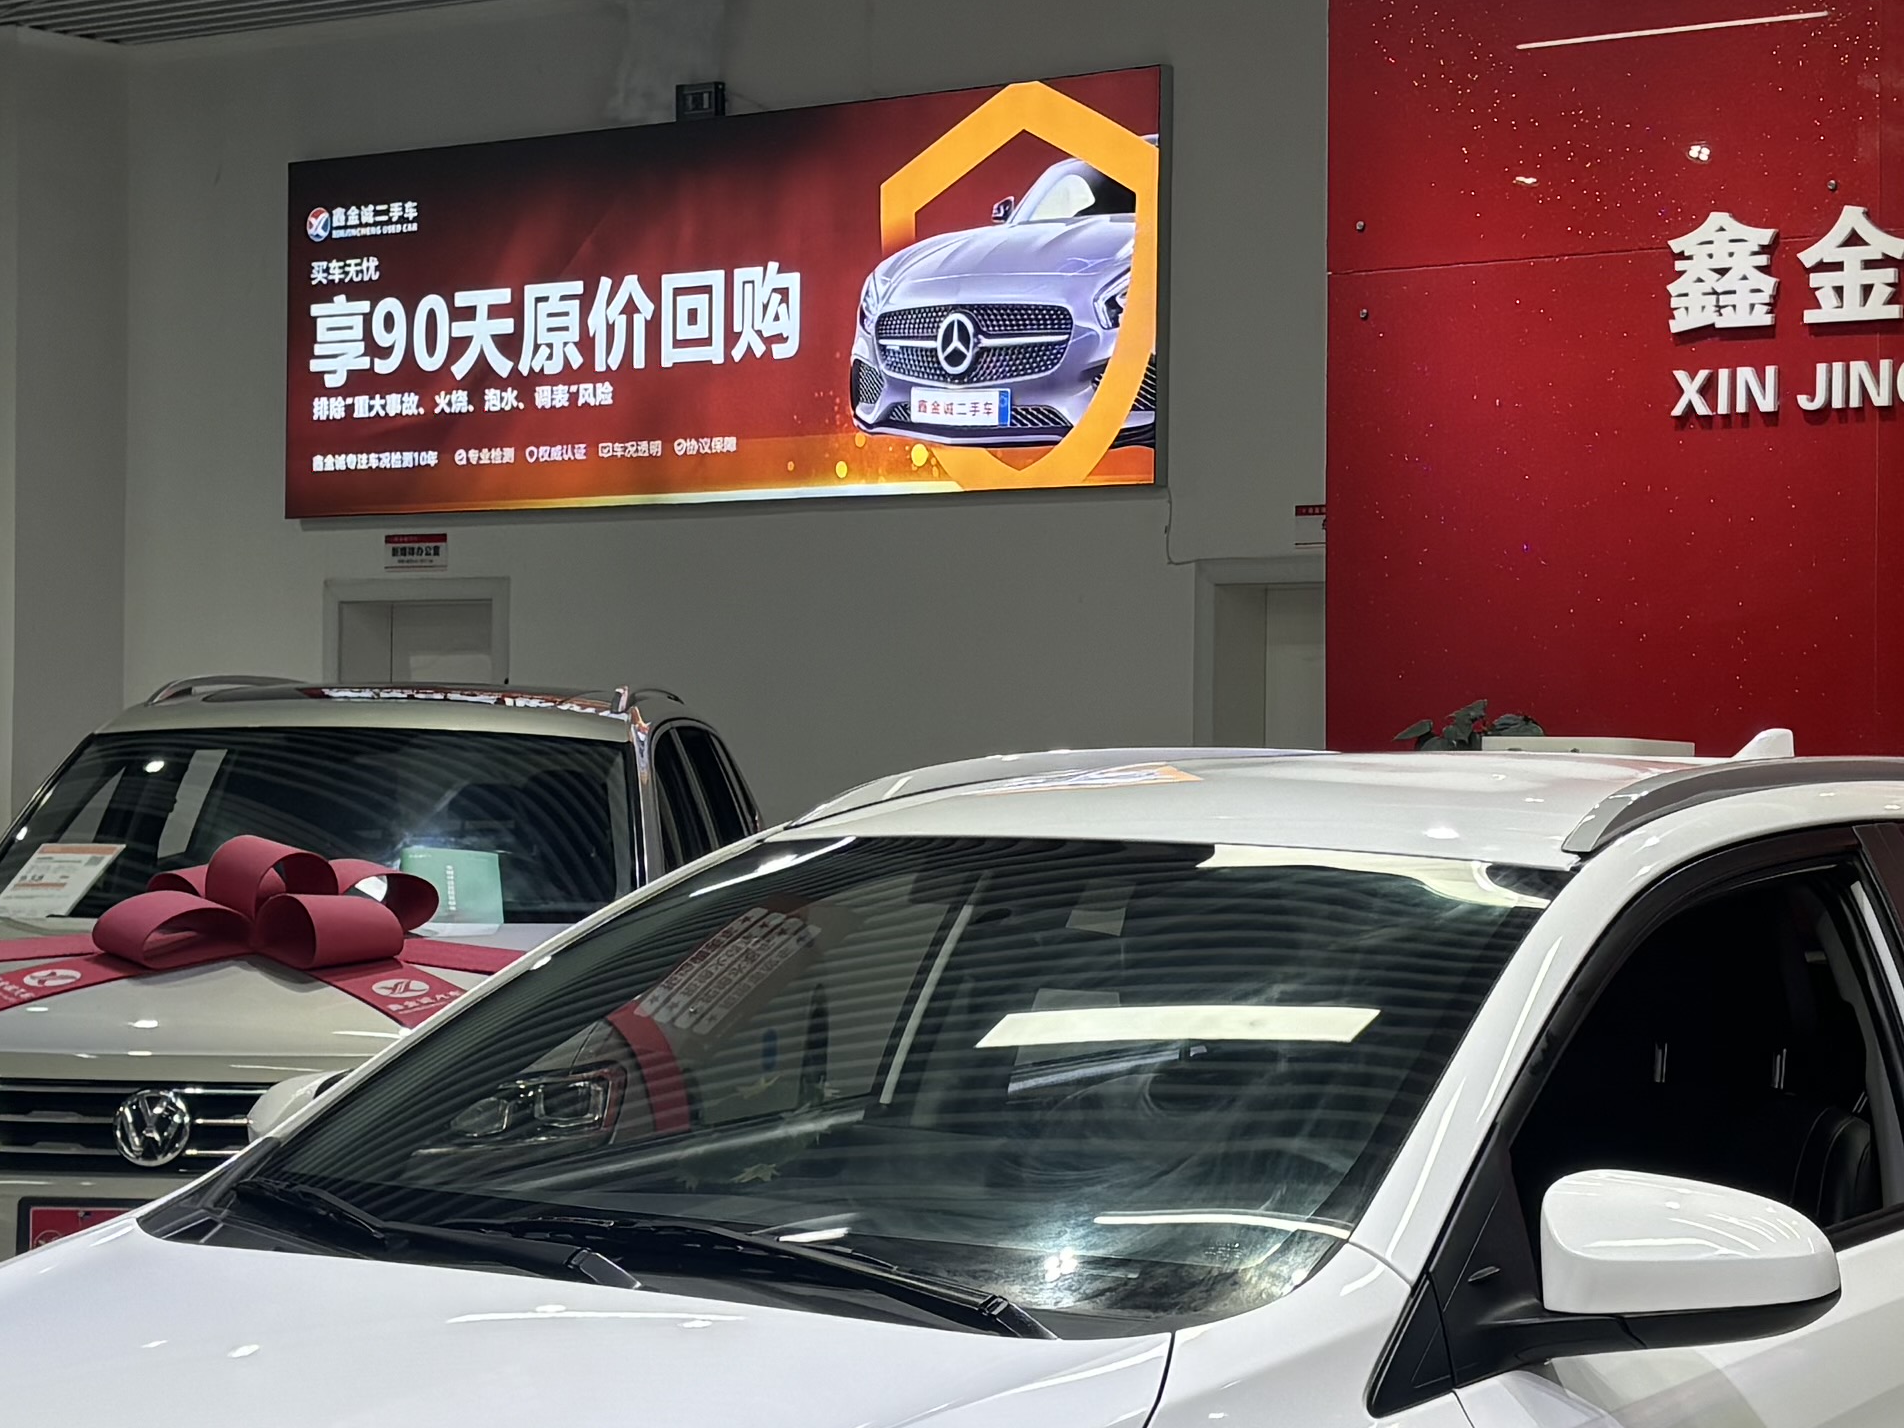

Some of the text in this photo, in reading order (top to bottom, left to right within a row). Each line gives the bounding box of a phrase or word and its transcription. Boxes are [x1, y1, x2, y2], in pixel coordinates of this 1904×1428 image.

[310, 256, 380, 285] 买车无忧
[309, 261, 800, 388] 享90天原价回购
[1671, 362, 1778, 417] XIN
